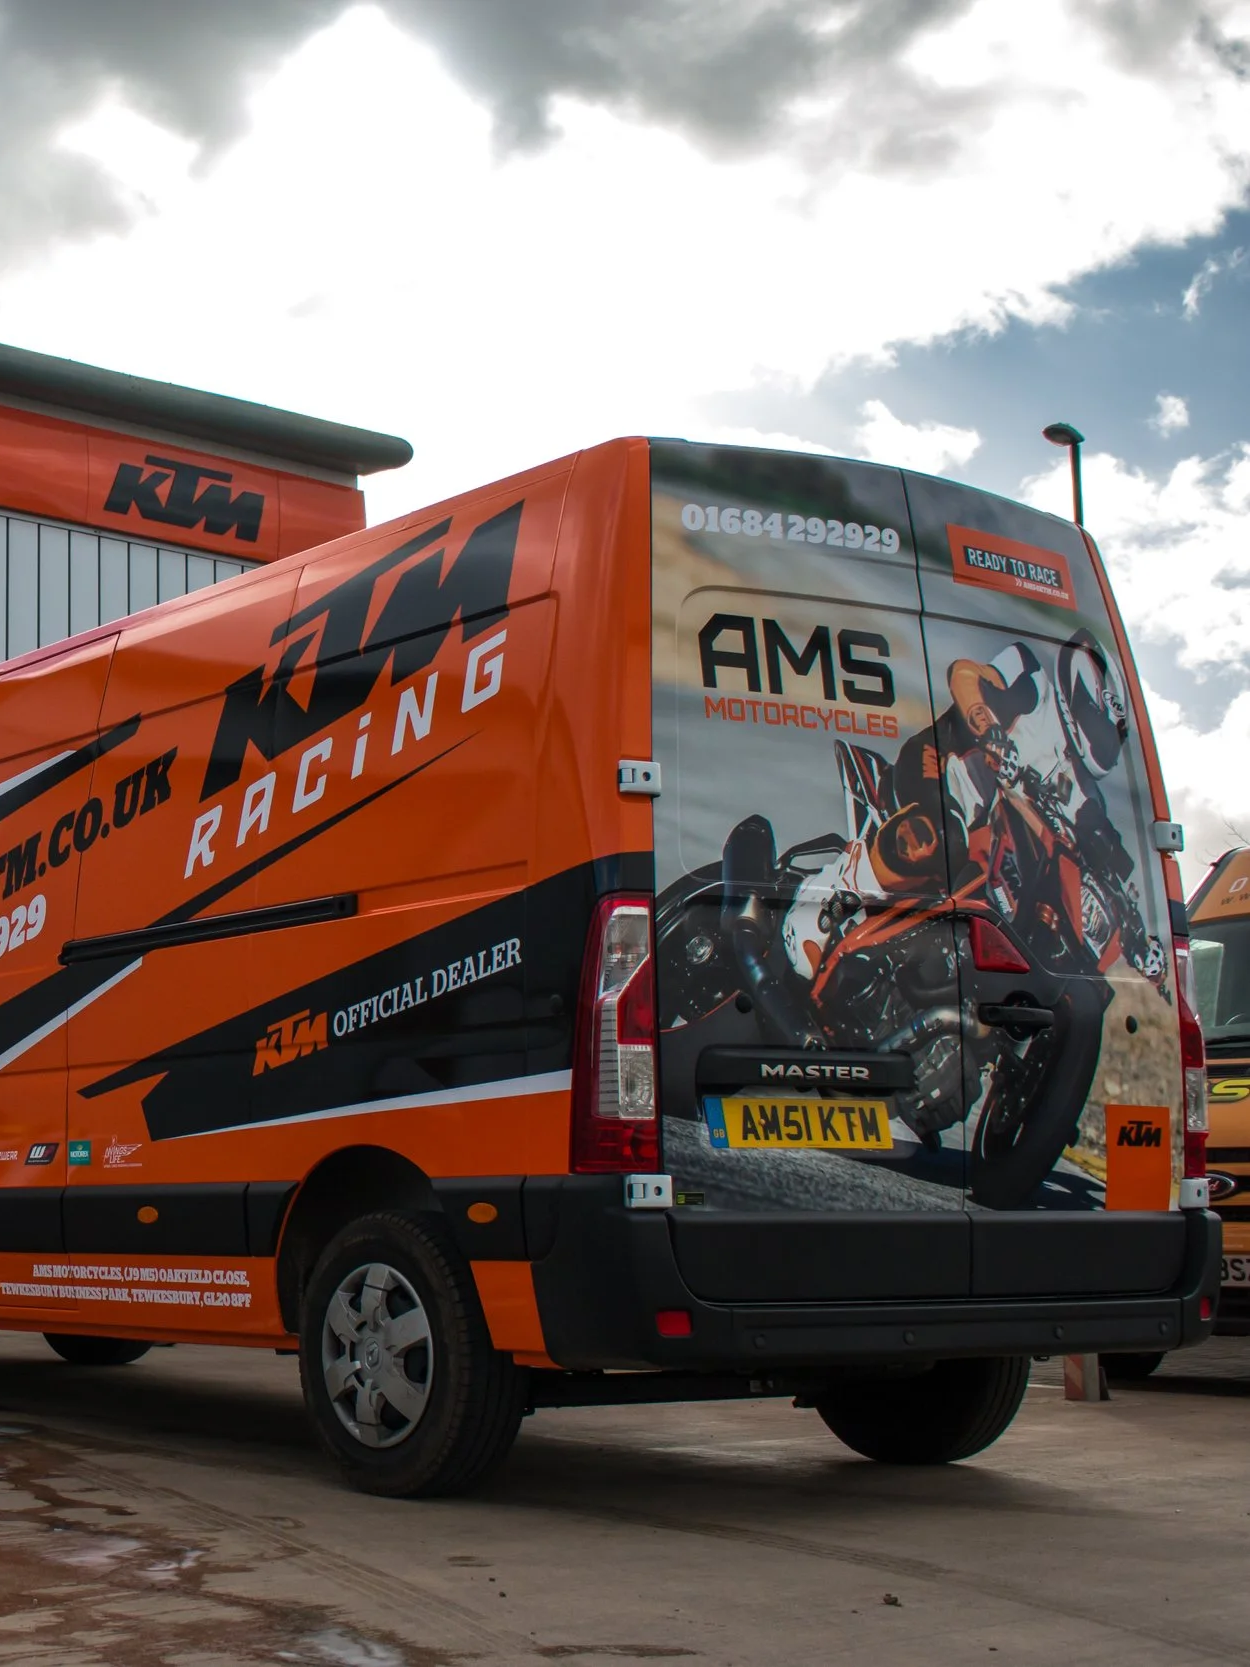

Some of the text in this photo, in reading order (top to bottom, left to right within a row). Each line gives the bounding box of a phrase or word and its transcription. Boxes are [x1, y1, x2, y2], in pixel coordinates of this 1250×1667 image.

[103, 455, 265, 543] KTM
[681, 503, 900, 554] 01684 292929
[967, 548, 1059, 587] READY TO RACE
[198, 499, 525, 803] KTM
[698, 613, 896, 708] AMS
[704, 696, 899, 738] MOTORCYCLES
[252, 937, 522, 1077] KTM OFFICIAL DEALER
[760, 1063, 870, 1081] MASTER
[742, 1105, 813, 1141] AM51
[818, 1106, 881, 1142] KTM
[1117, 1120, 1162, 1147] KTM
[0, 1282, 58, 1297] TEWKESBURY
[101, 1286, 131, 1303] PARK,
[131, 1289, 204, 1307] TEWKESBURY,
[33, 1264, 52, 1278] AMS
[53, 1265, 124, 1282] MOTORCYCLES,
[159, 1268, 212, 1284] OAKFIELD
[213, 1270, 249, 1287] CLOSE,
